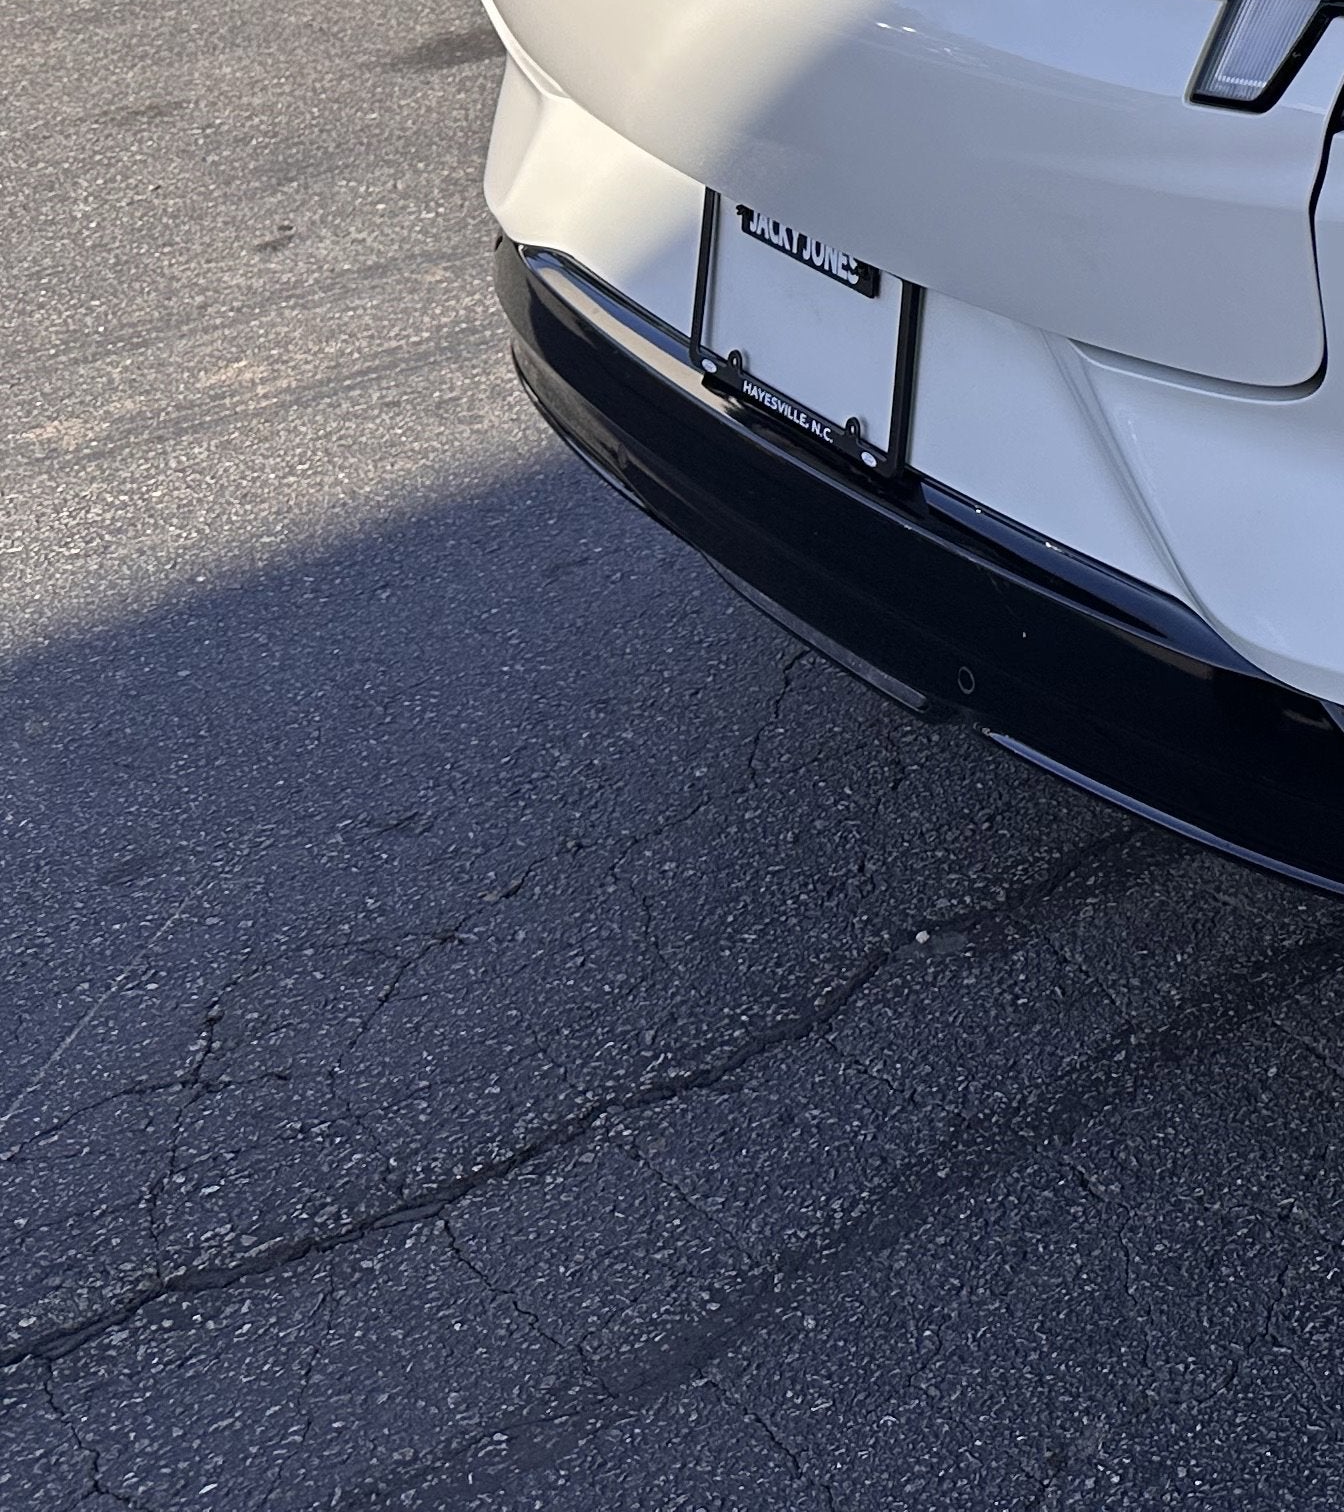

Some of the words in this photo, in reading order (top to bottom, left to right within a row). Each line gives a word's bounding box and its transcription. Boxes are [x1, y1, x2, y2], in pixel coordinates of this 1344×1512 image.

[749, 211, 800, 254] JACKY
[742, 379, 810, 429] HAYESVILLE,
[811, 419, 834, 444] N.C.
